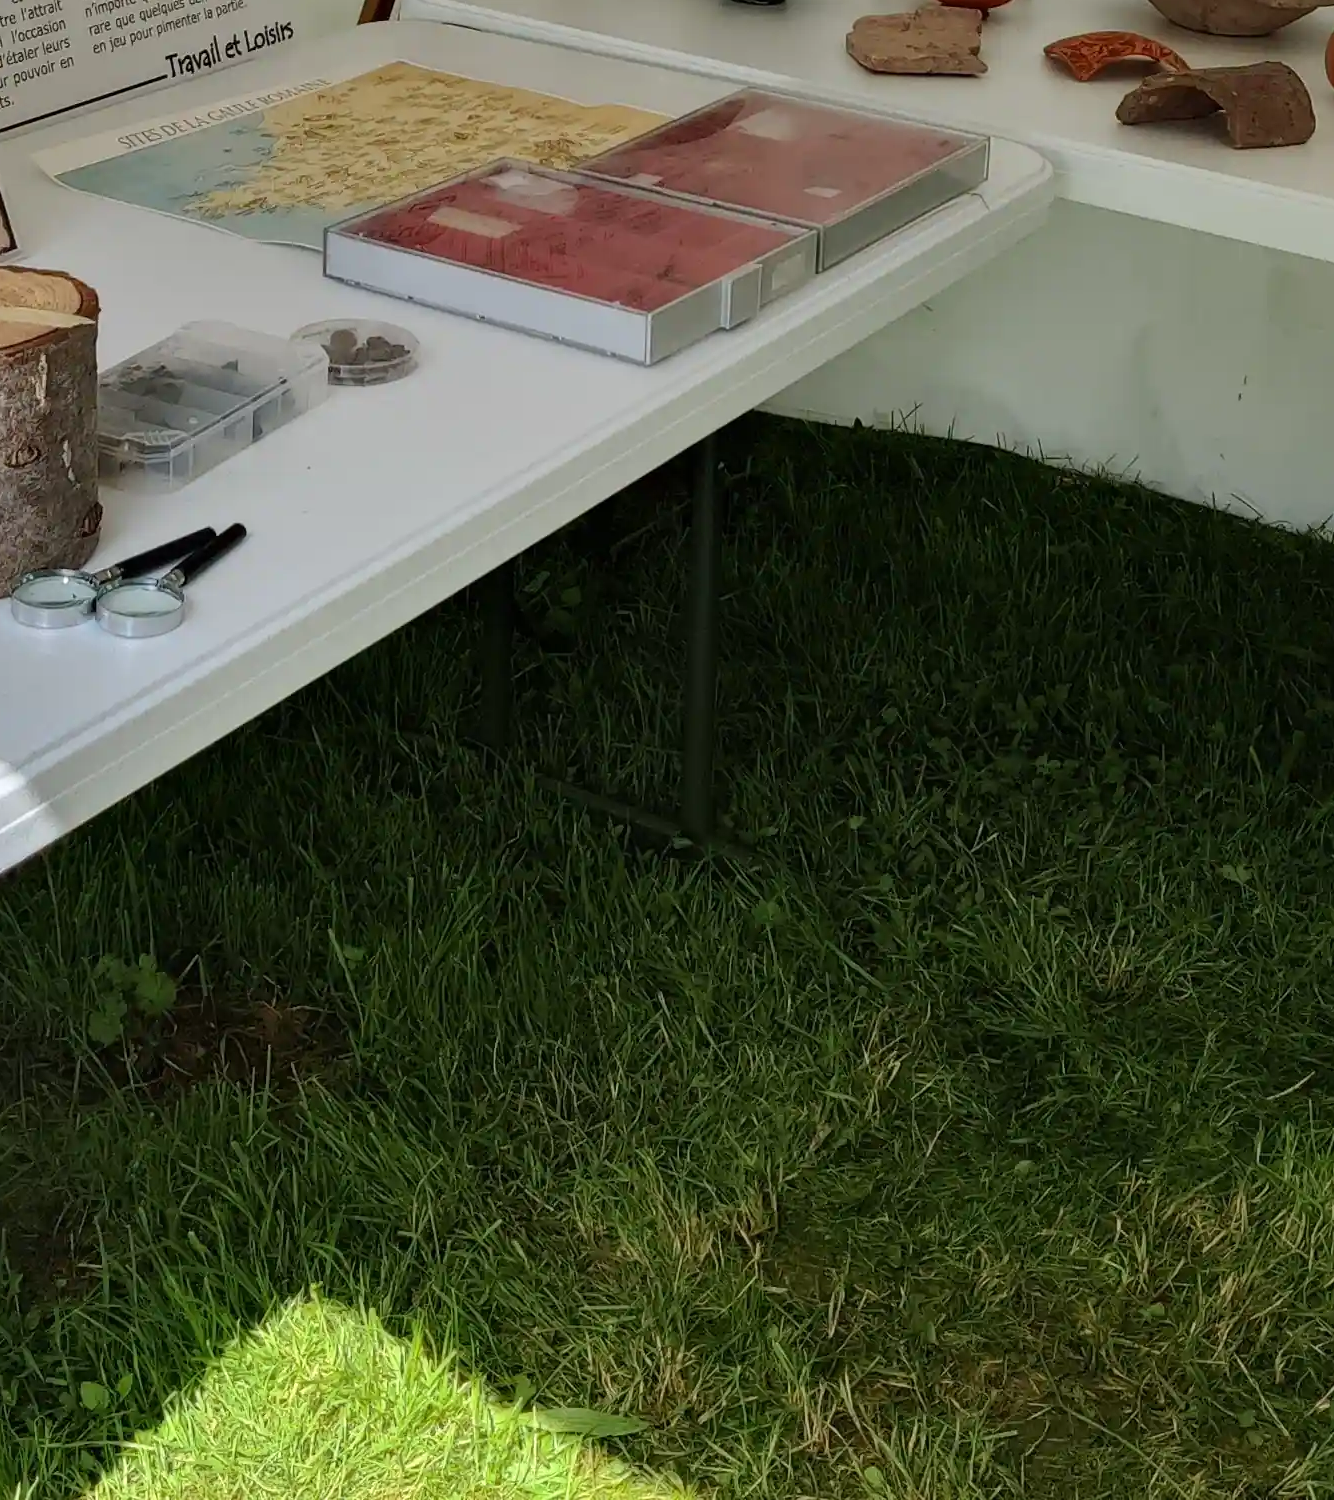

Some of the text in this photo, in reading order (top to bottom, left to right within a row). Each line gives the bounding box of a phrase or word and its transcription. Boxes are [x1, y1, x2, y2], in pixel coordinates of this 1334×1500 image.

[164, 21, 294, 79] Travail et Loisirs
